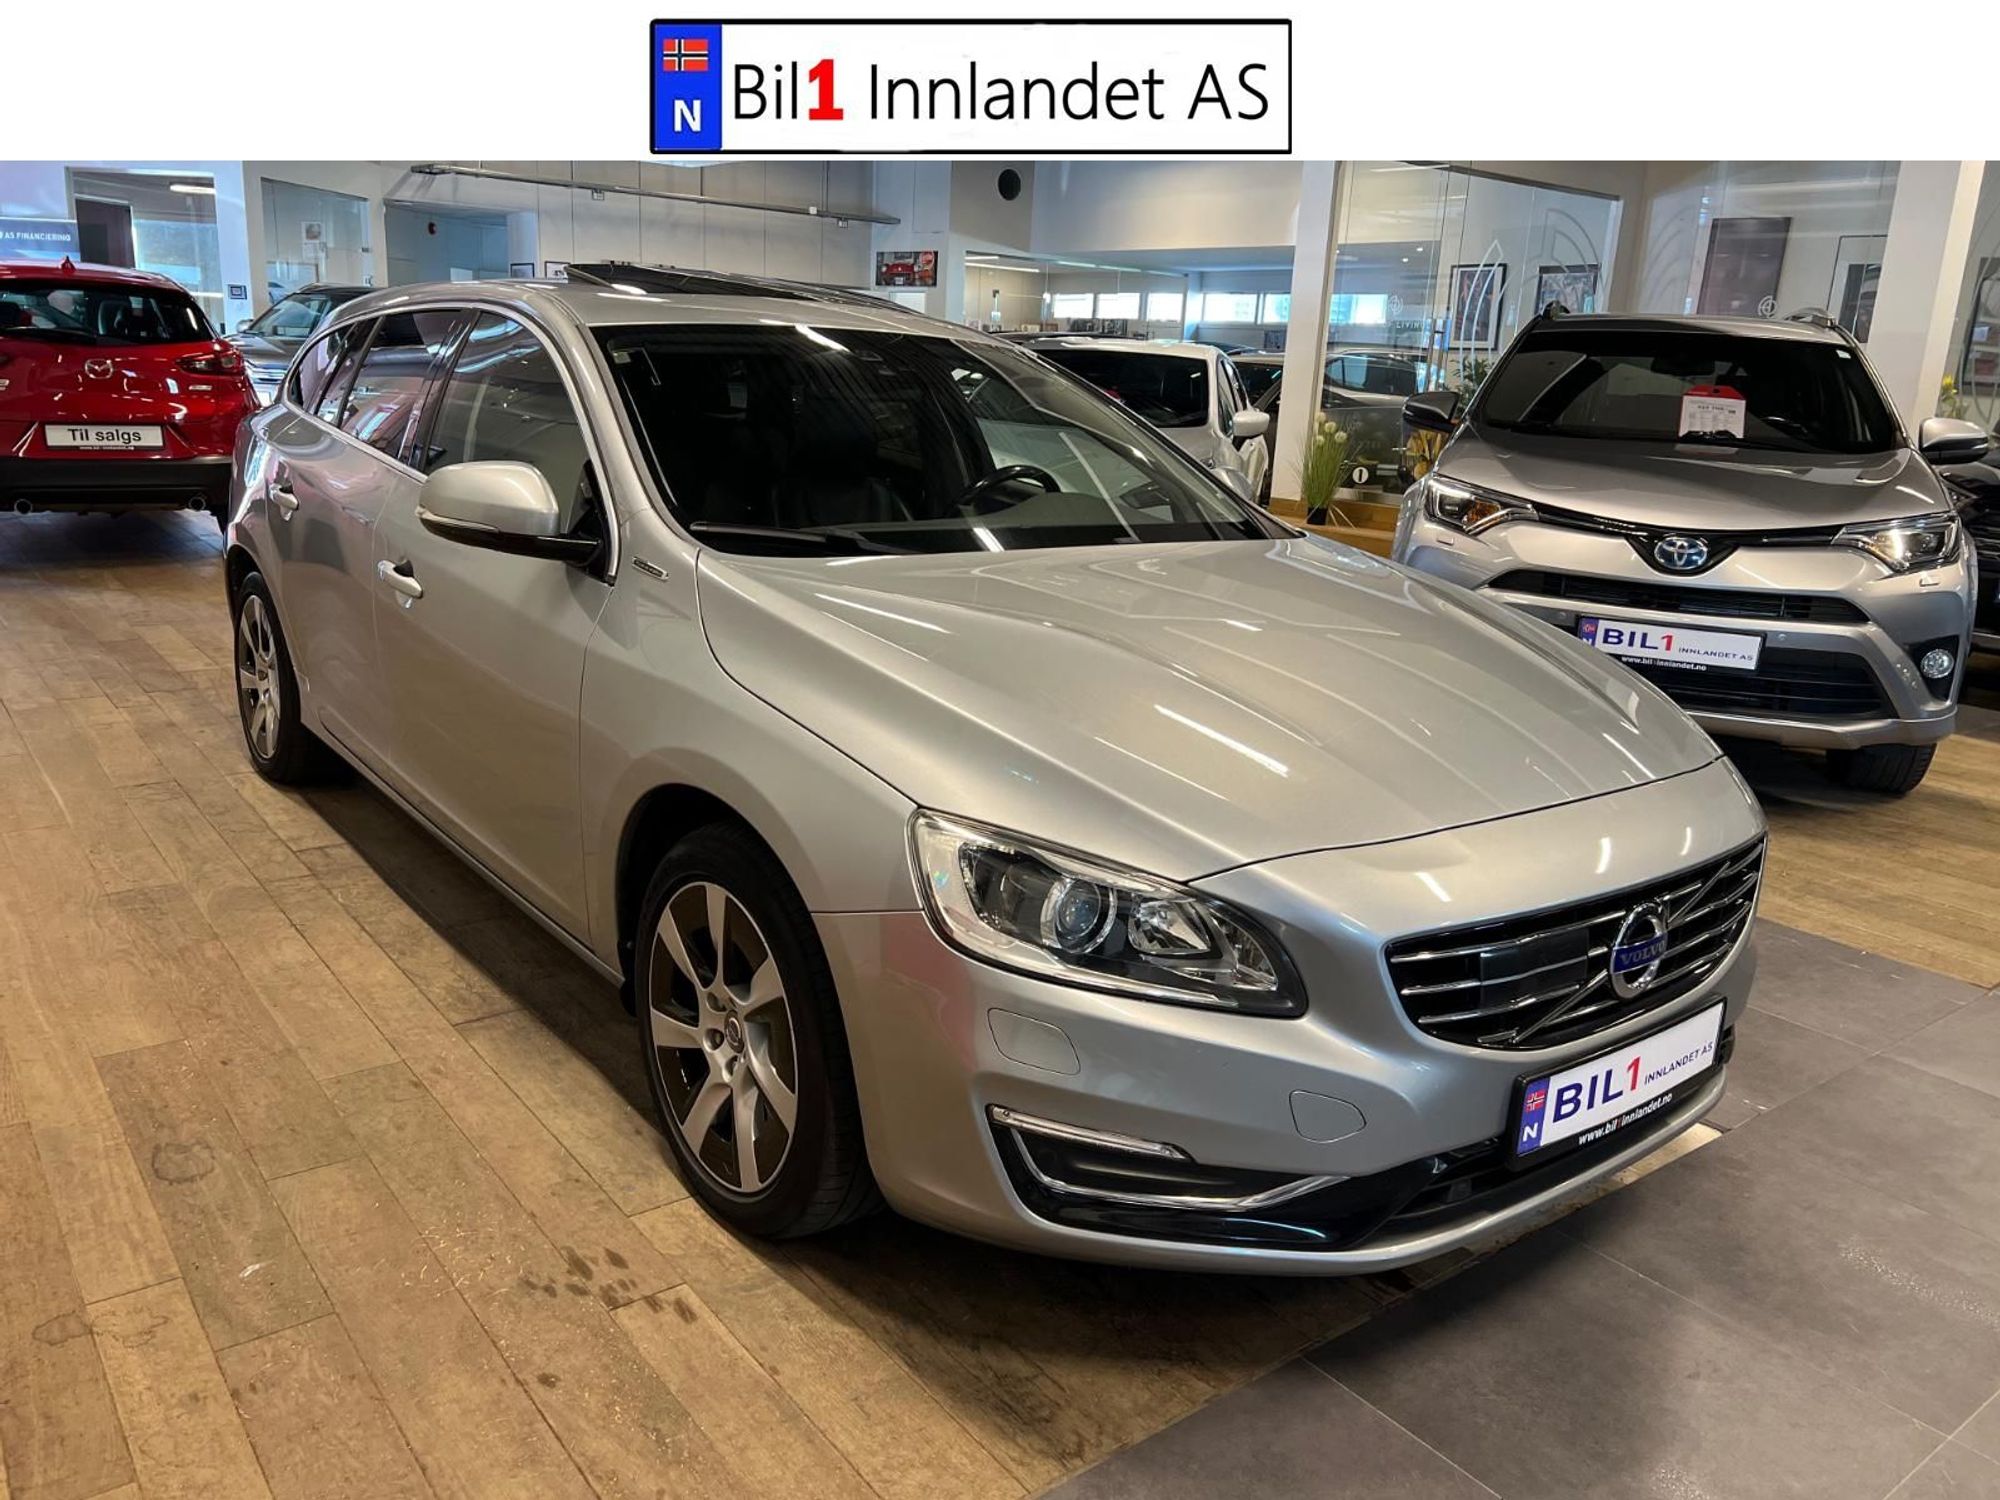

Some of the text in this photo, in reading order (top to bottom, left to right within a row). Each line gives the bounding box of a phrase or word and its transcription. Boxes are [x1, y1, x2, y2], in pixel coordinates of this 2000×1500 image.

[68, 429, 142, 445] Til salgs
[1602, 628, 1674, 651] BIL1
[1678, 647, 1737, 660] INNLANDET
[1621, 941, 1665, 964] VOLVO
[1552, 1041, 1713, 1124] BIL1 INNLANDET AS
[1522, 1122, 1538, 1142] N
